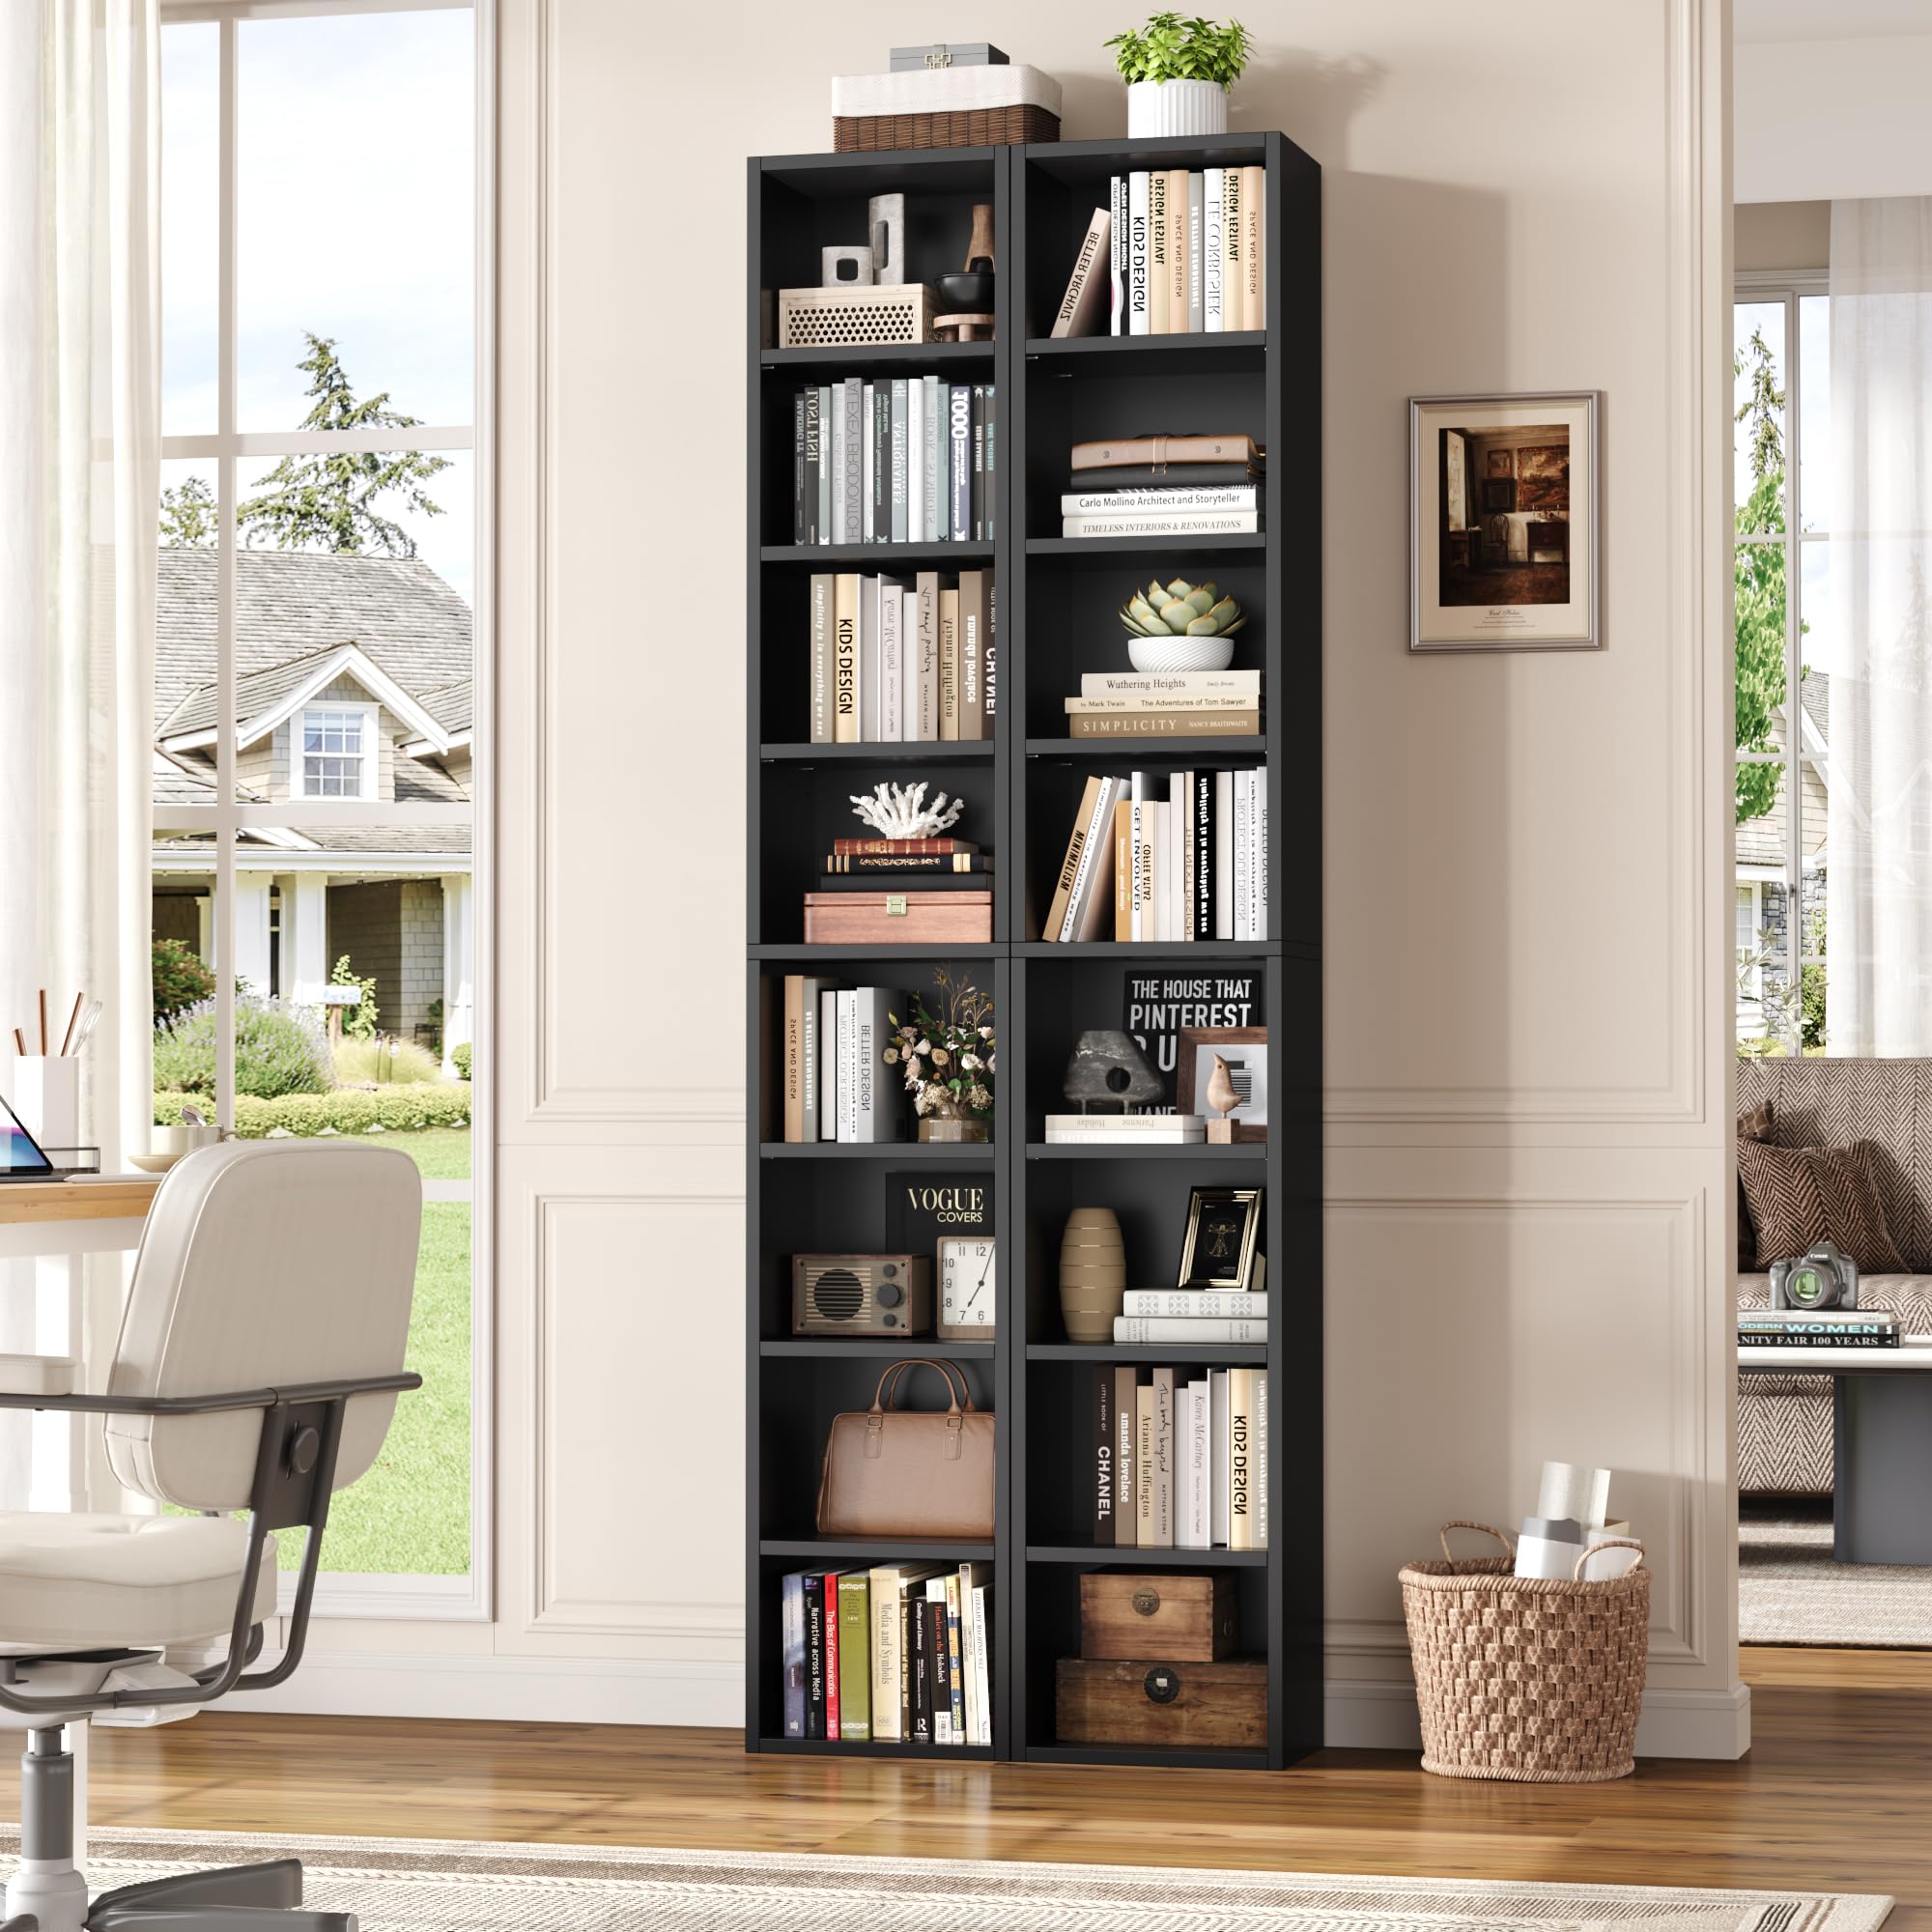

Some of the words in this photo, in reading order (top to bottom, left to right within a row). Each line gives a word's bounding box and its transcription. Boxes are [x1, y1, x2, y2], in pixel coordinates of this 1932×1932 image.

[1079, 498, 1101, 508] Carlo
[1103, 497, 1135, 507] Mollino
[1138, 495, 1176, 505] Architect
[1178, 495, 1193, 504] and
[1195, 494, 1240, 506] Storyteller
[1083, 525, 1123, 533] TIMELESS
[1125, 523, 1171, 532] INTERIORS
[1181, 521, 1241, 530] RENOVATIONS
[838, 618, 852, 654] KIDS
[838, 659, 852, 715] DESIGN
[1107, 680, 1151, 691] Wuthering
[1153, 679, 1186, 691] Heights
[1221, 698, 1247, 707] Sawyer
[1083, 719, 1178, 732] SIMPLICITY
[1061, 831, 1084, 891] MINIMALISM
[1132, 980, 1160, 999] THE
[1163, 980, 1211, 999] HOUSE
[1215, 980, 1252, 999] THAT
[1129, 1003, 1252, 1030] PINTEREST
[907, 1188, 983, 1210] VOGUE
[937, 1211, 983, 1223] COVERS
[958, 1246, 966, 1256] 11
[976, 1246, 986, 1257] 12
[945, 1258, 954, 1268] 10
[945, 1279, 952, 1289] 9
[945, 1297, 952, 1307] 8
[958, 1310, 966, 1321] 7
[978, 1310, 984, 1321] 6
[1738, 1336, 1775, 1345] NITY
[1776, 1336, 1808, 1345] FAIR
[1121, 1412, 1131, 1455] amanda
[1142, 1414, 1151, 1456] Arianna
[1097, 1446, 1111, 1520] CHANEL
[1121, 1459, 1131, 1503] lovelace
[1140, 1461, 1151, 1519] Huffington
[827, 1609, 836, 1624] The
[881, 1603, 893, 1628] Media
[881, 1631, 893, 1646] and
[811, 1648, 820, 1675] across
[879, 1649, 894, 1685] Symbols
[937, 1653, 946, 1684] Holodeck
[812, 1677, 821, 1701] Media
